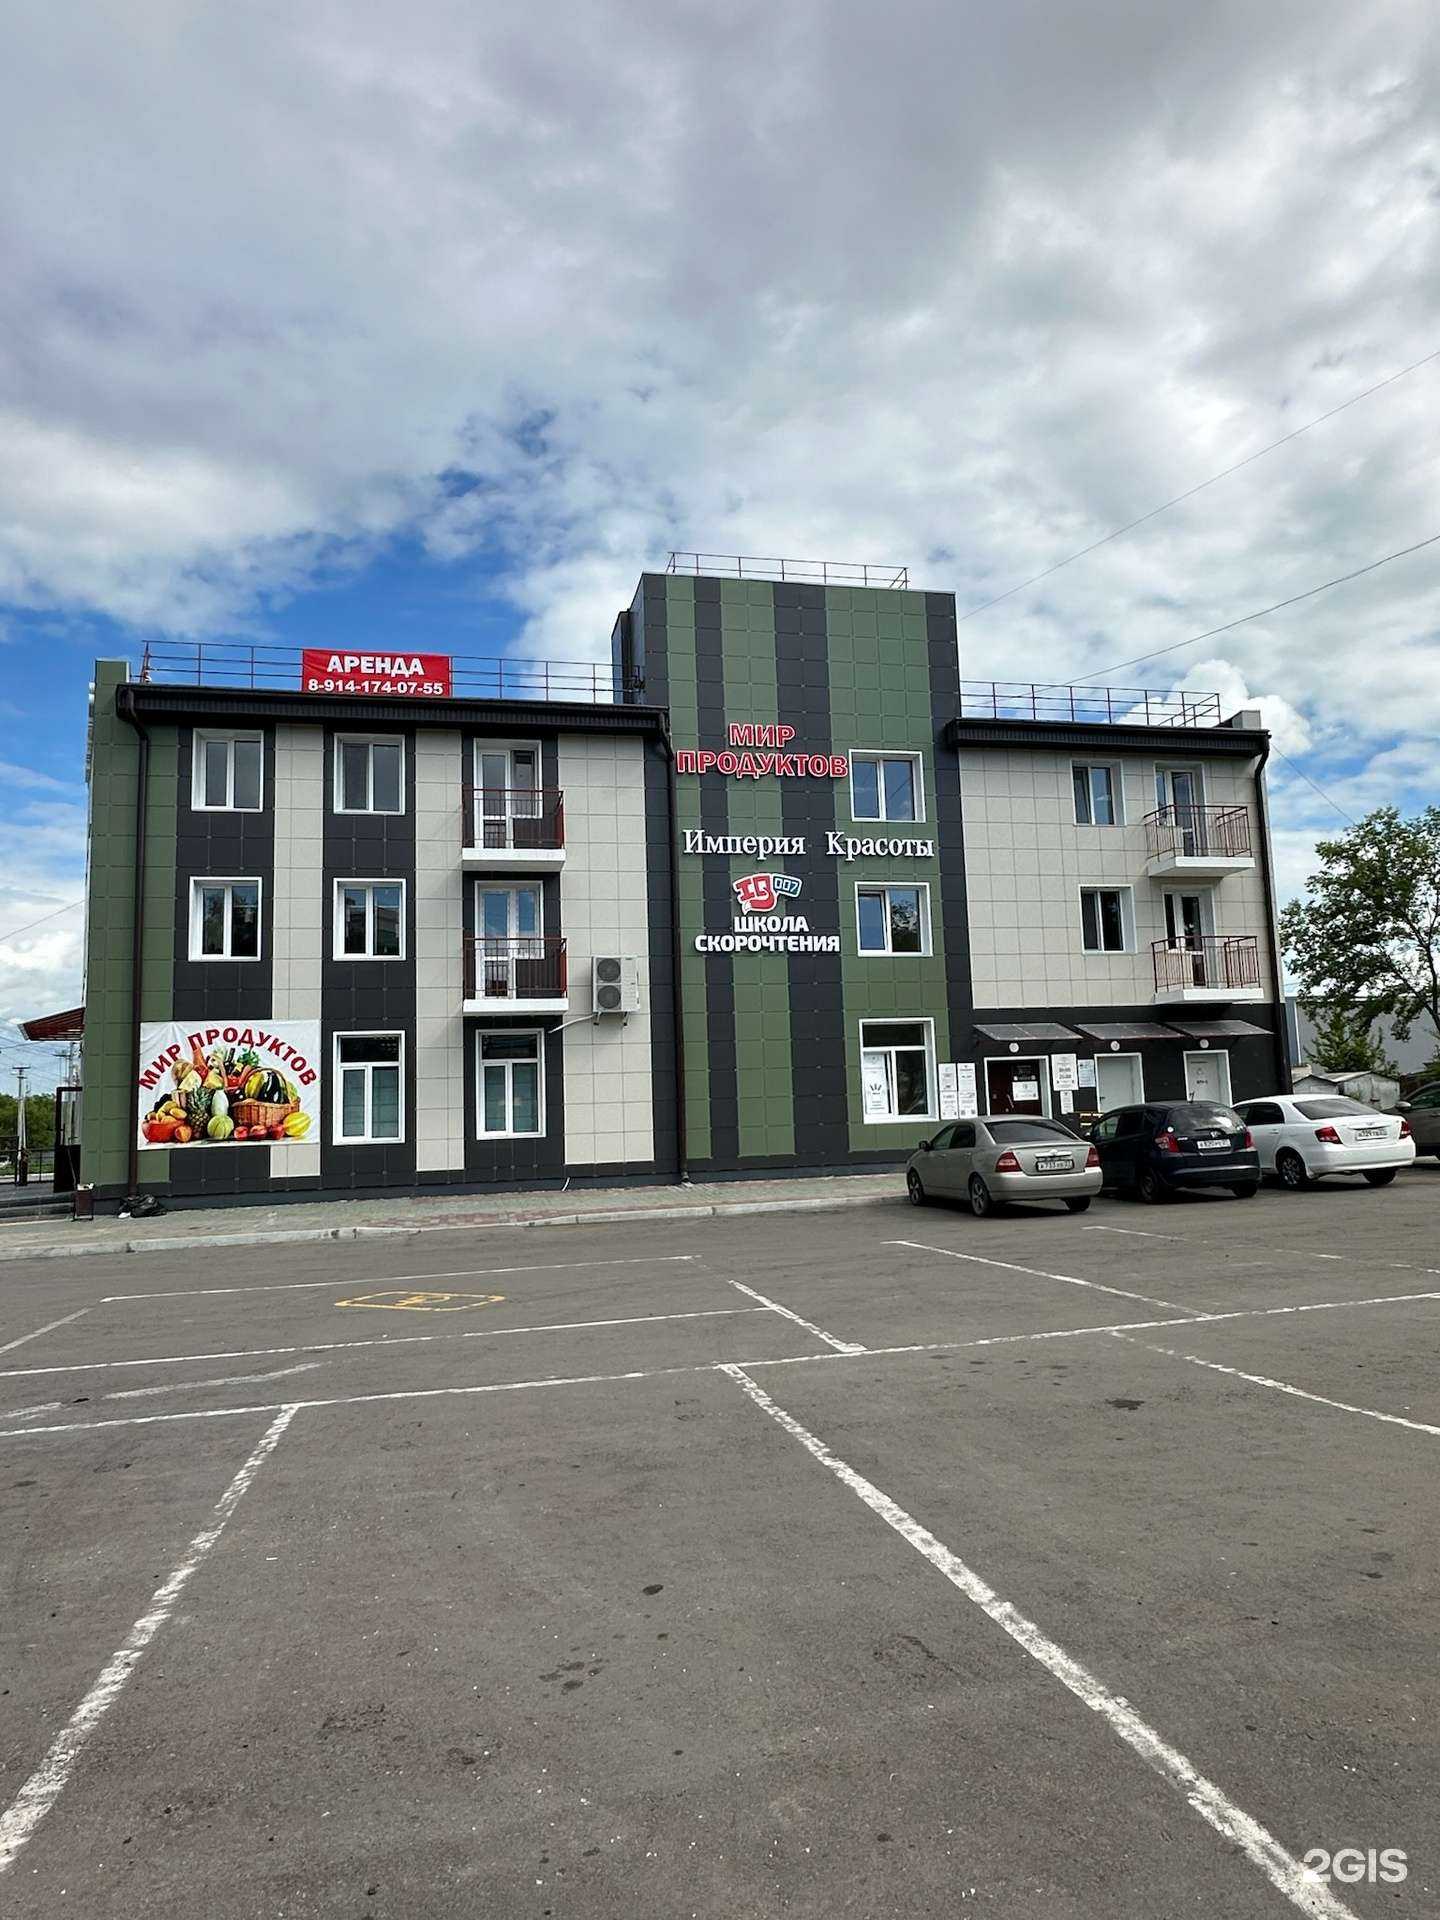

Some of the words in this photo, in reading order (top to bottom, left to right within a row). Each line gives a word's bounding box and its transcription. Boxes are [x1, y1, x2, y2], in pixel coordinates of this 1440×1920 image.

[326, 654, 425, 678] АРЕНДА
[307, 678, 444, 695] 8-914-174-07-55
[729, 722, 796, 749] МИР
[676, 749, 849, 779] ПРОДУКТОВ
[682, 829, 807, 860] Империя
[825, 831, 935, 861] Красоты
[774, 877, 799, 892] 007
[734, 915, 810, 933] ШКОЛА
[695, 935, 841, 953] СКОРОЧТЕНИЯ
[139, 1044, 182, 1090] МИР
[186, 1026, 318, 1086] ПРОДУКТОВ
